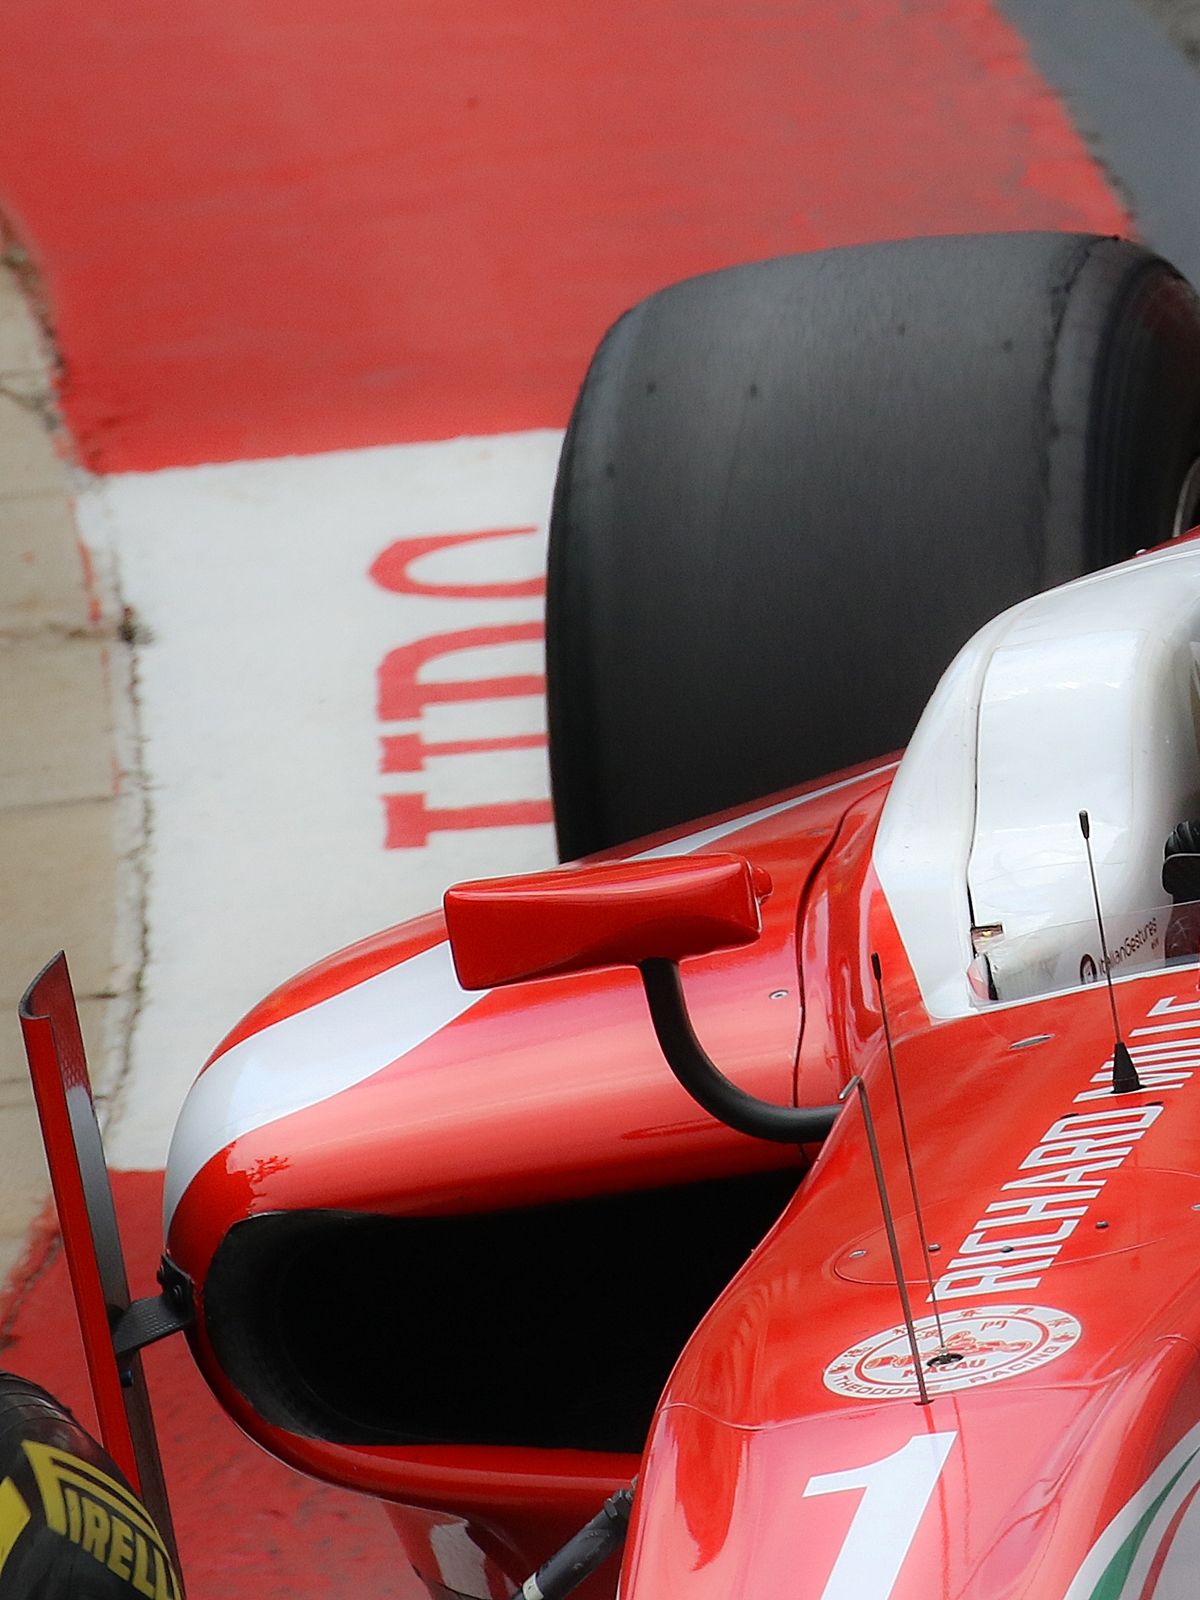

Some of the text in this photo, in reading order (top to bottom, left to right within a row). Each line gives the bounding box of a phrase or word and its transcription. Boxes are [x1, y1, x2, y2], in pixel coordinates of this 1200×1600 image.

[927, 1103, 1164, 1303] RICHARD
[968, 1344, 1060, 1386] RACING
[802, 1430, 958, 1600] 1
